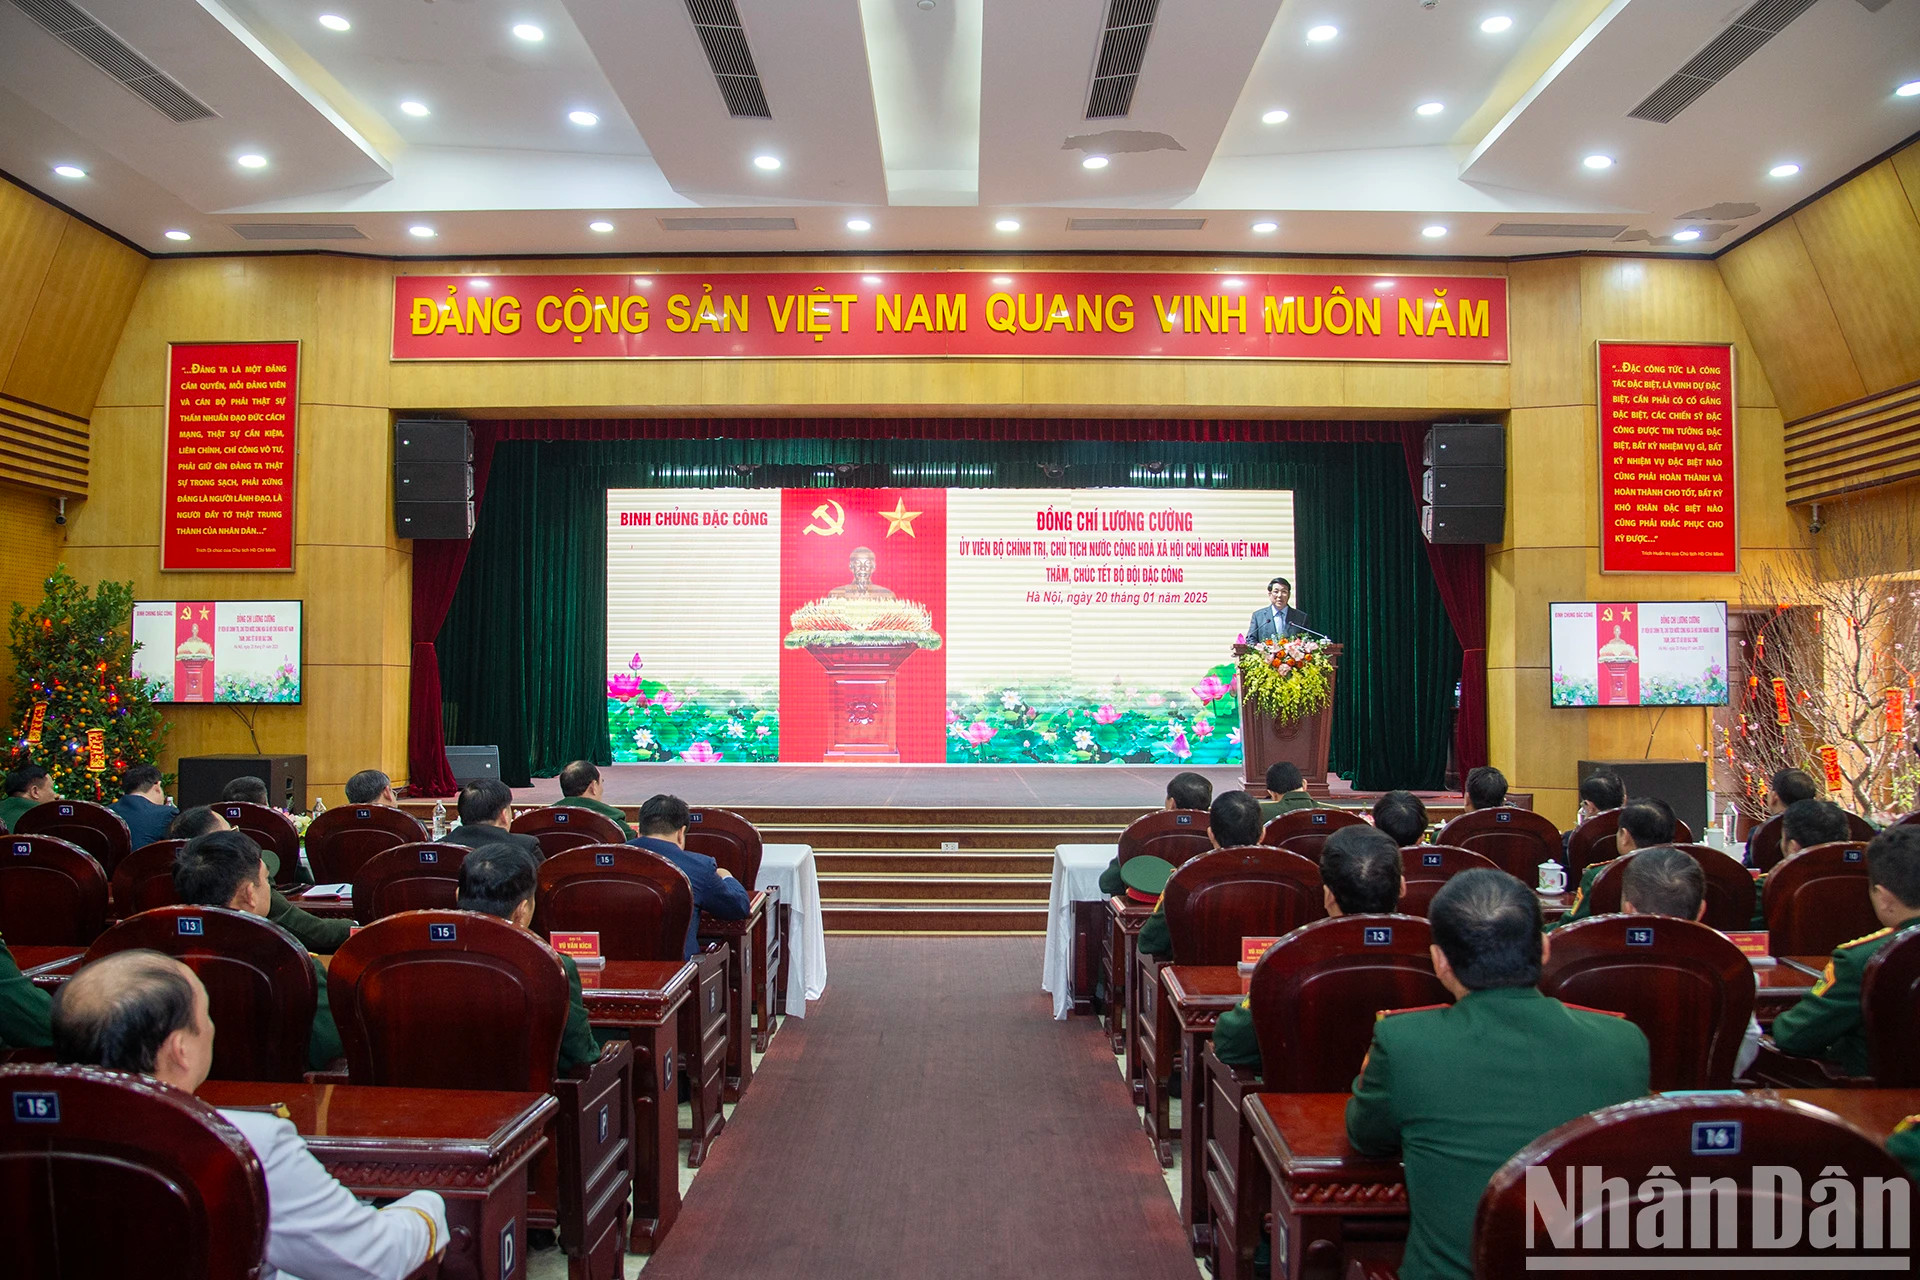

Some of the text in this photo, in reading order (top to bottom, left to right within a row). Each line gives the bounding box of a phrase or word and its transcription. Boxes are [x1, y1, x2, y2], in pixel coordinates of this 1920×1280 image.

[410, 284, 1489, 343] ĐẢNG CỘNG SẢN VIỆT NAM QUANG VINH MUÔN NĂM
[620, 506, 768, 528] BINH CHỦNG ĐẶC CÔNG
[1036, 504, 1193, 532] ĐỒNG CHÍ LƯƠNG CƯỜNG
[959, 536, 1270, 560] ỦY VIÊN BỘ CHÍNH TRỊ, CHỦ TỊCH NƯỚC CỘNG HOÀ XÃ HỘI CHỦ NGHĨA VIỆT NAM
[1046, 564, 1184, 586] THĂM, CHÚC TẾT BỘ ĐỘI ĐẶC CÔNG
[1026, 591, 1208, 606] Hà Nội, ngày 20 tháng 01 năm 2025
[186, 922, 196, 930] 13
[438, 928, 449, 936] 15
[1373, 932, 1384, 940] 13
[1635, 932, 1646, 941] 15
[666, 1057, 672, 1081] C
[28, 1099, 47, 1114] 15
[602, 1112, 607, 1136] P
[1706, 1129, 1728, 1146] 16
[504, 1233, 513, 1272] D
